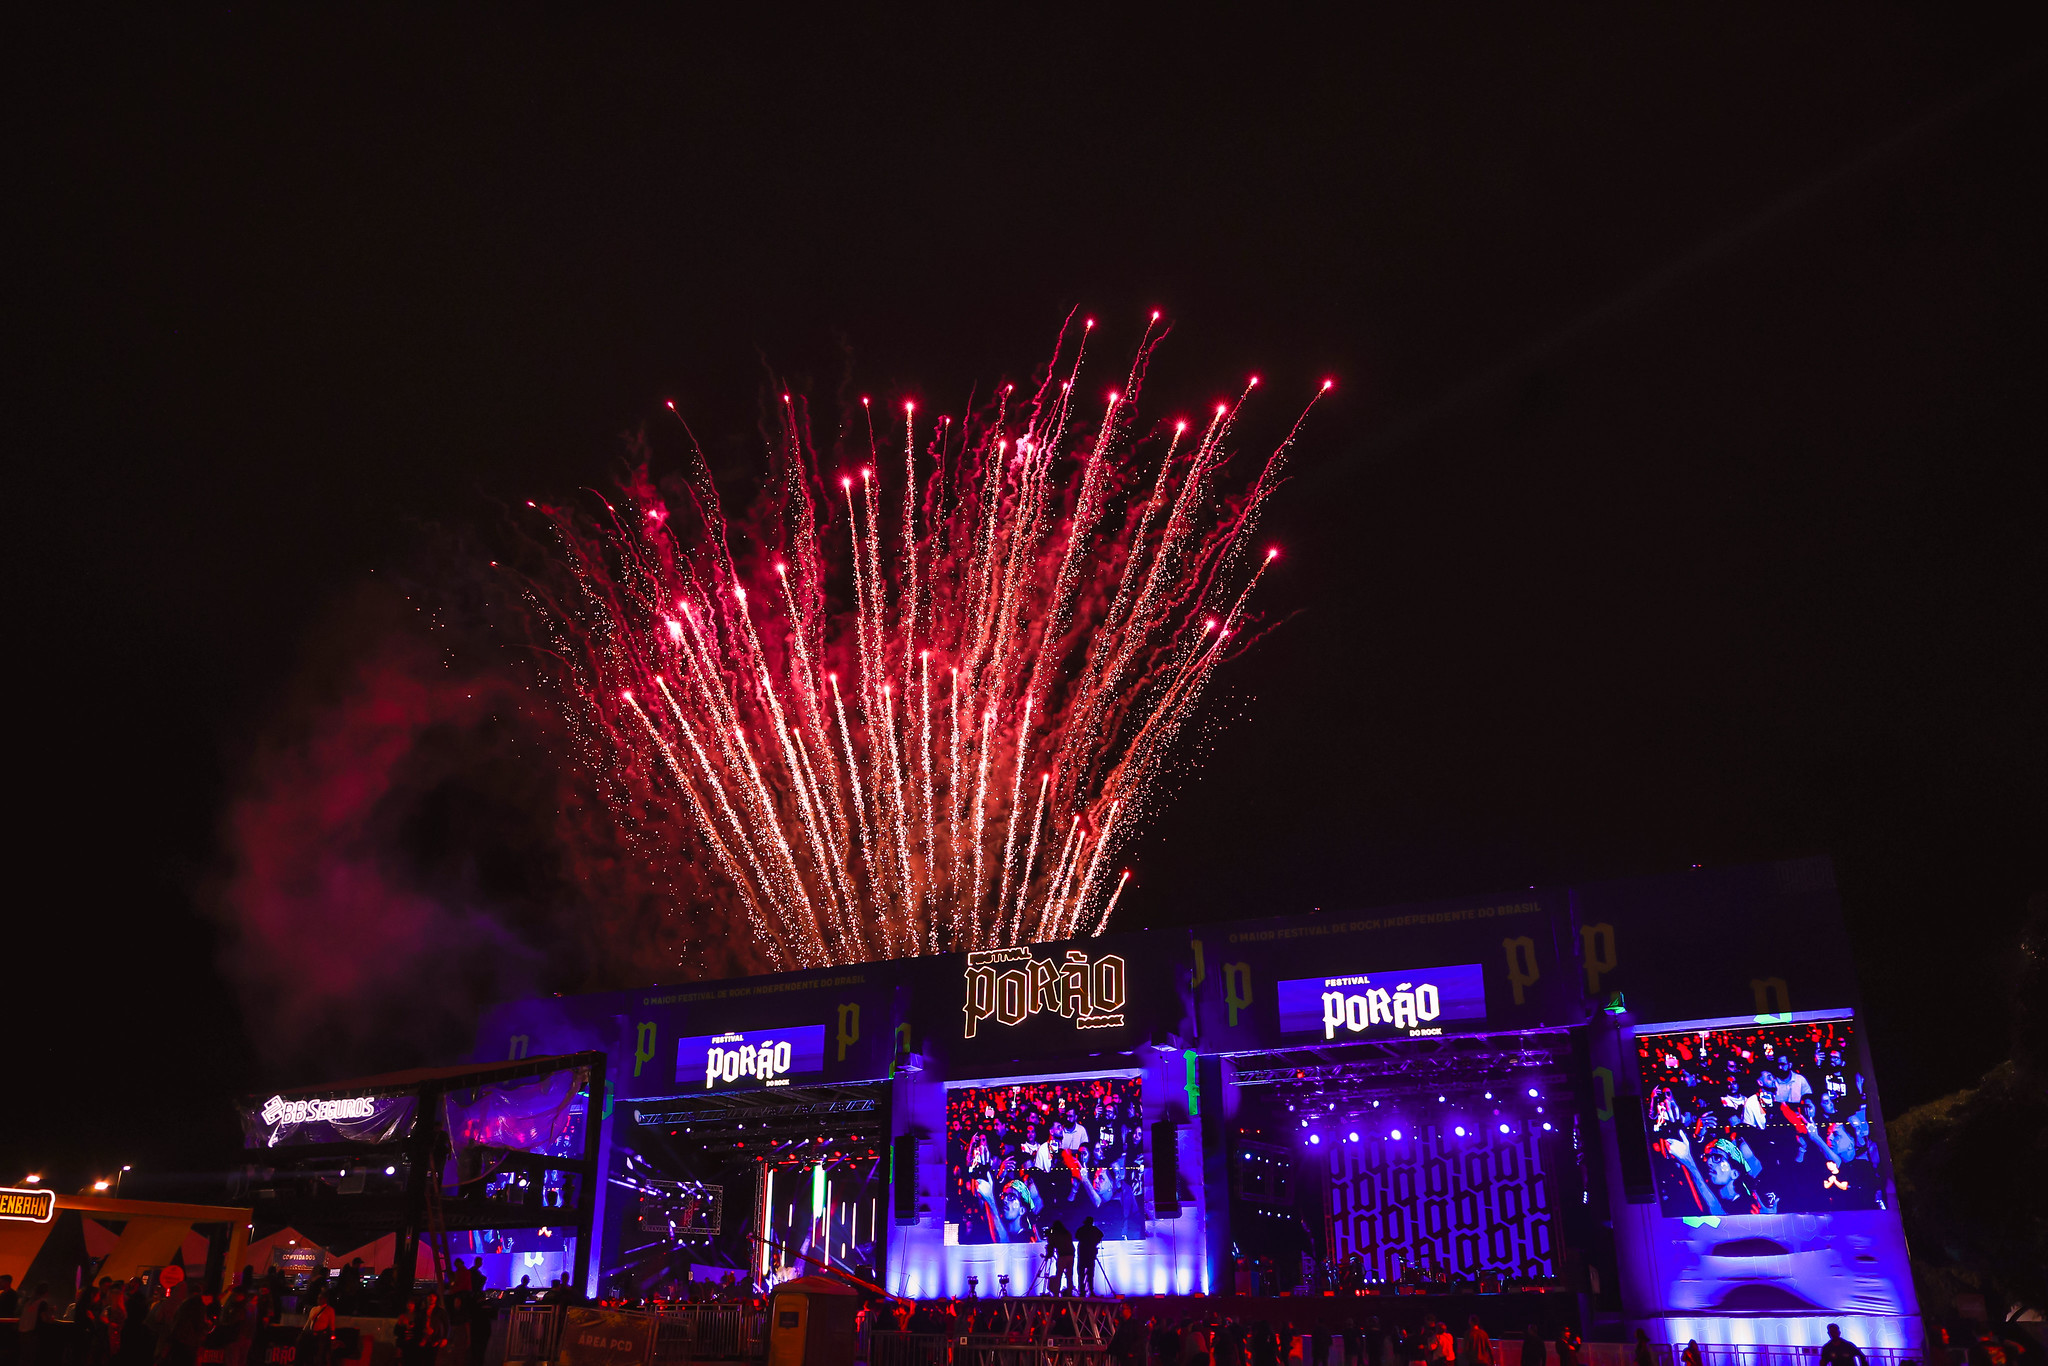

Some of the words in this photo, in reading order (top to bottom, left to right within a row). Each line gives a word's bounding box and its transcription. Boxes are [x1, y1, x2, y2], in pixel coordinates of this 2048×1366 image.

[1229, 934, 1237, 943] O
[1239, 931, 1274, 942] MAIOR
[1277, 926, 1329, 938] FESTIVAL
[1332, 923, 1347, 933] DE
[1350, 919, 1380, 931] ROCK
[1383, 909, 1475, 928] INDEPENDENTE
[1478, 907, 1494, 918] DO
[1498, 902, 1541, 915] BRASIL
[643, 997, 649, 1006] O
[650, 995, 676, 1005] MAIOR
[678, 991, 715, 1002] FESTIVAL
[717, 990, 728, 998] DE
[729, 987, 751, 998] ROCK
[753, 979, 819, 995] INDEPENDENTE
[820, 978, 833, 987] DO
[834, 975, 865, 986] BRASIL
[1325, 976, 1370, 988] FESTIVAL
[1321, 982, 1441, 1040] PORÃO
[711, 1034, 744, 1044] FESTIVAL
[1409, 1029, 1420, 1037] DO
[1421, 1027, 1443, 1037] ROCK
[705, 1040, 792, 1089] PORÃO
[0, 1195, 48, 1217] ENBAHN
[578, 1330, 607, 1349] ÁREA
[609, 1338, 633, 1352] PCD
